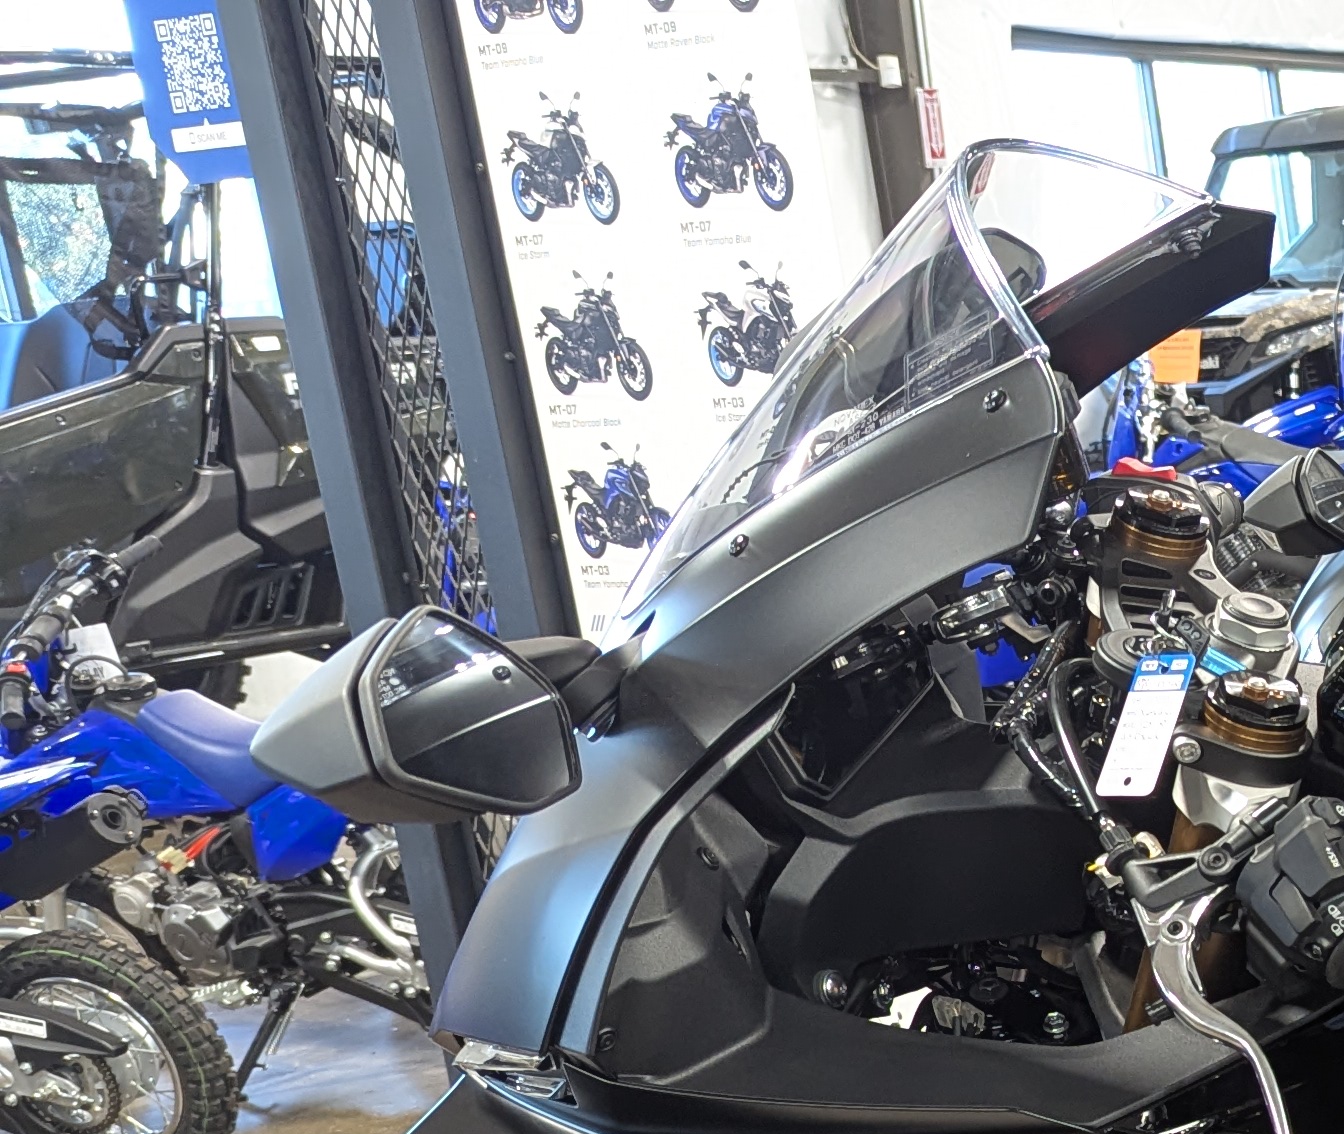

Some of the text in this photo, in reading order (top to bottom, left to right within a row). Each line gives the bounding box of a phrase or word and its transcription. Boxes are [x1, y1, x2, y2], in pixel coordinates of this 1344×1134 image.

[644, 21, 676, 35] MT-09
[670, 36, 692, 47] Raven
[694, 33, 715, 45] Black
[478, 43, 508, 56] MT-09
[481, 54, 544, 71] Team Yamaha Blue
[197, 132, 227, 143] SCAN ME
[680, 220, 712, 234] MT-07
[515, 234, 544, 247] MT-07
[683, 234, 752, 248] Team Yamaha Blue
[518, 250, 550, 261] Ice Storm
[549, 404, 577, 416] MT-07
[713, 397, 745, 410] MT-03
[603, 417, 622, 427] Black
[715, 411, 726, 422] Ice
[581, 565, 610, 577] MT-03
[584, 579, 601, 589] Team
